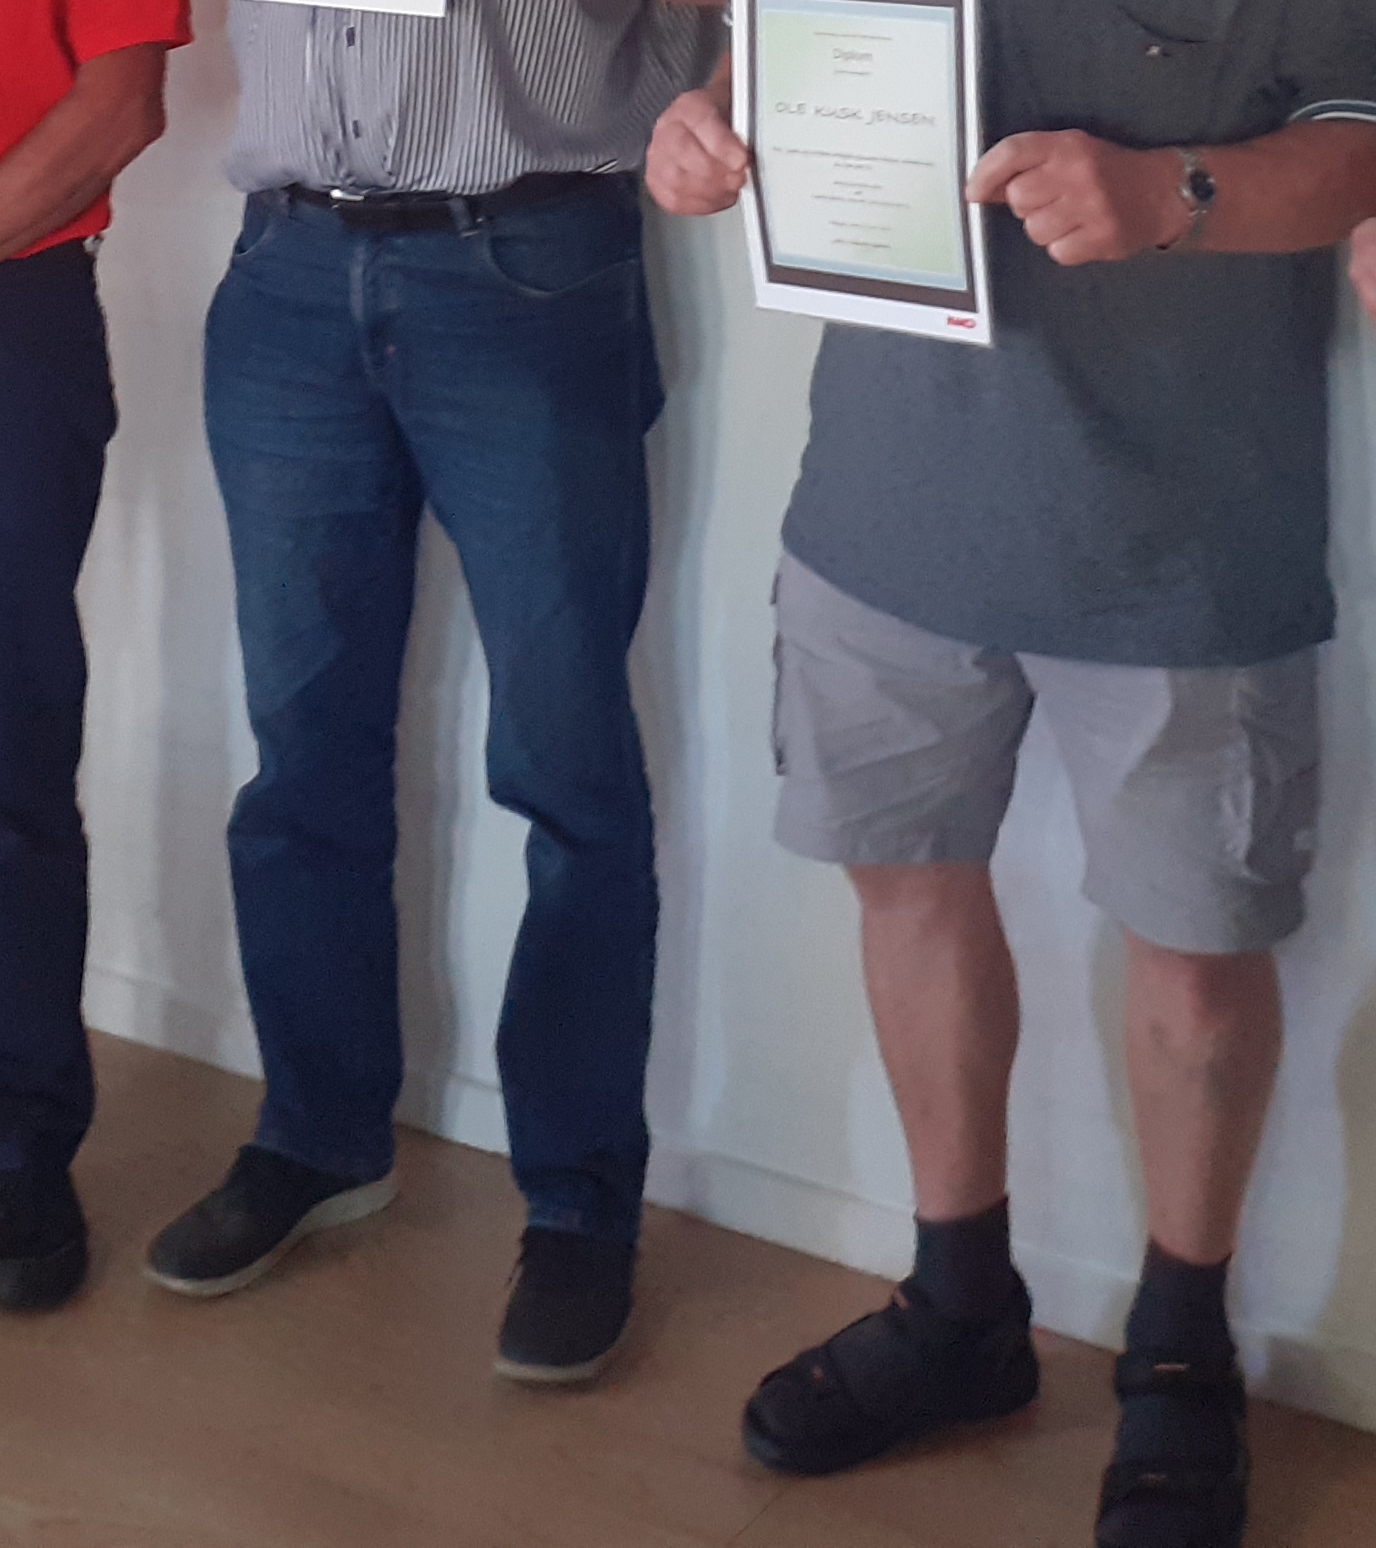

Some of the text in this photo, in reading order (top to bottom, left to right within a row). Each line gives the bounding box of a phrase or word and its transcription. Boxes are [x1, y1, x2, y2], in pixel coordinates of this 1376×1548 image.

[775, 101, 937, 127] OLE KUSK JENSEN
